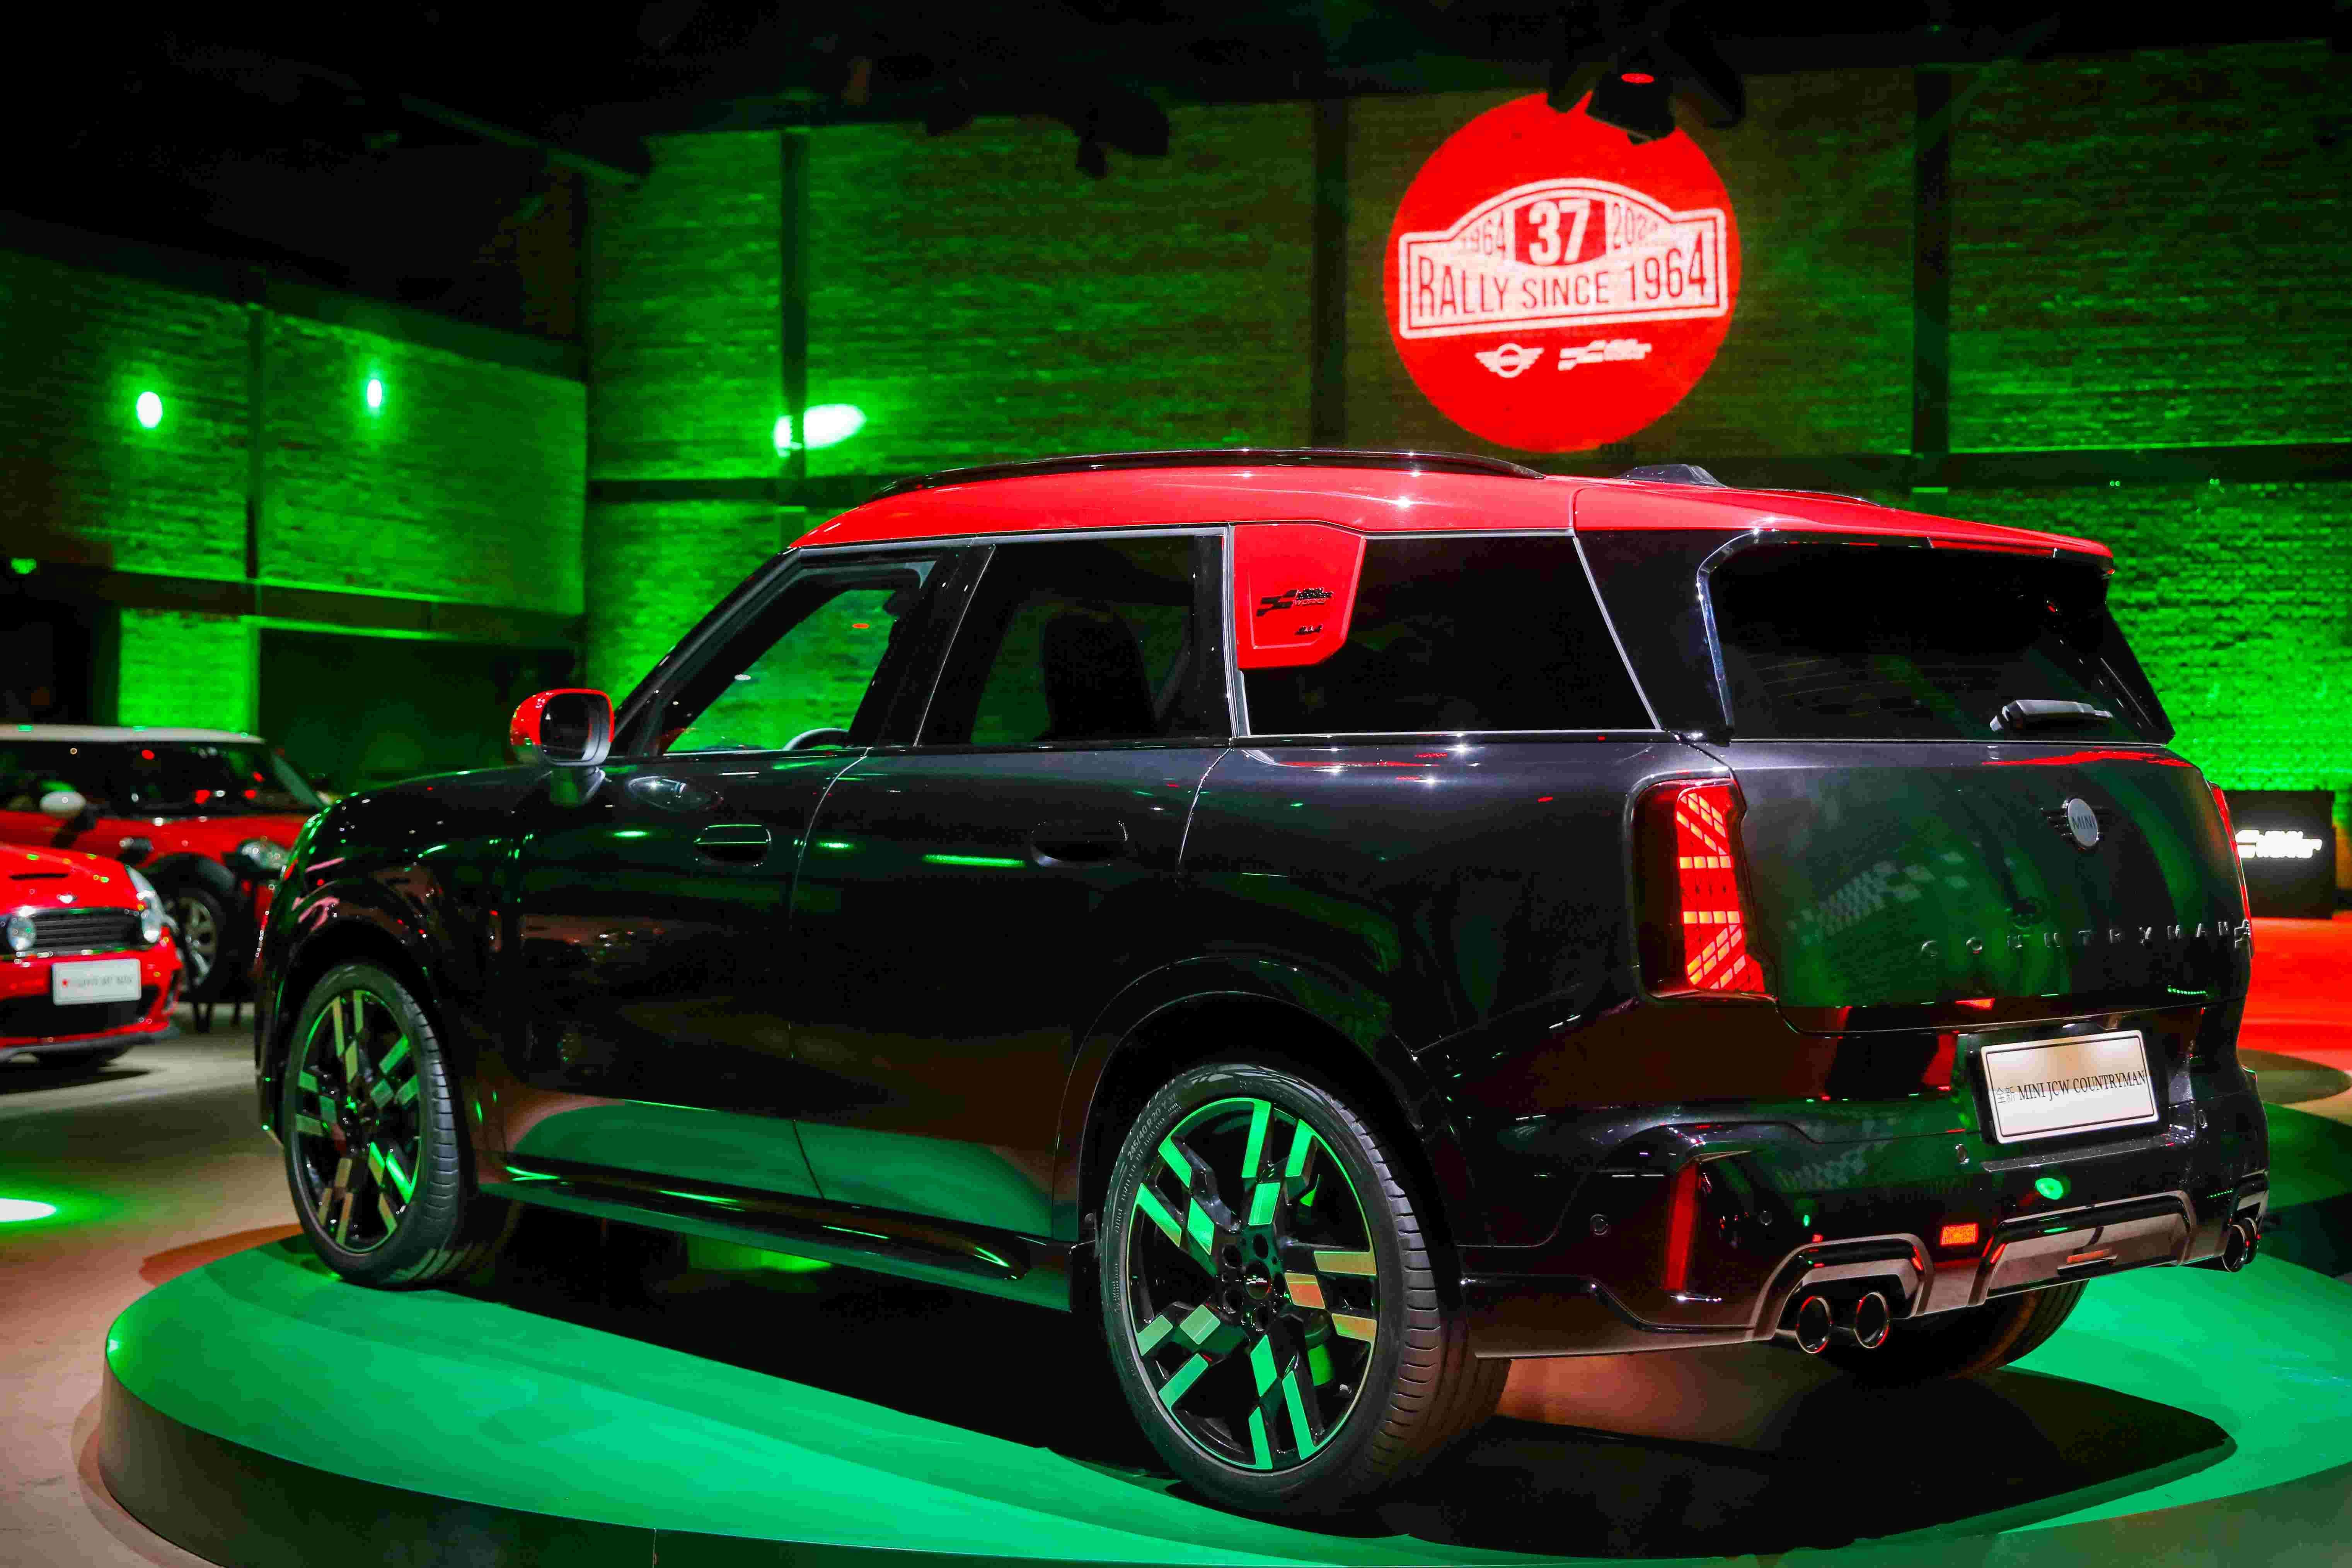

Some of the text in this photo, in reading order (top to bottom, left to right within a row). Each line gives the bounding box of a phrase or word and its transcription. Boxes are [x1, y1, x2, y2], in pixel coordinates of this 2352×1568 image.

[1529, 199, 1590, 266] 37
[1419, 230, 1707, 317] RALLY SINCE 1964
[2072, 816, 2097, 829] MINI
[1921, 921, 2229, 956] COUNTRYMAN
[1995, 1070, 2146, 1103] 全新 MINI JCW COUNTRYMAN
